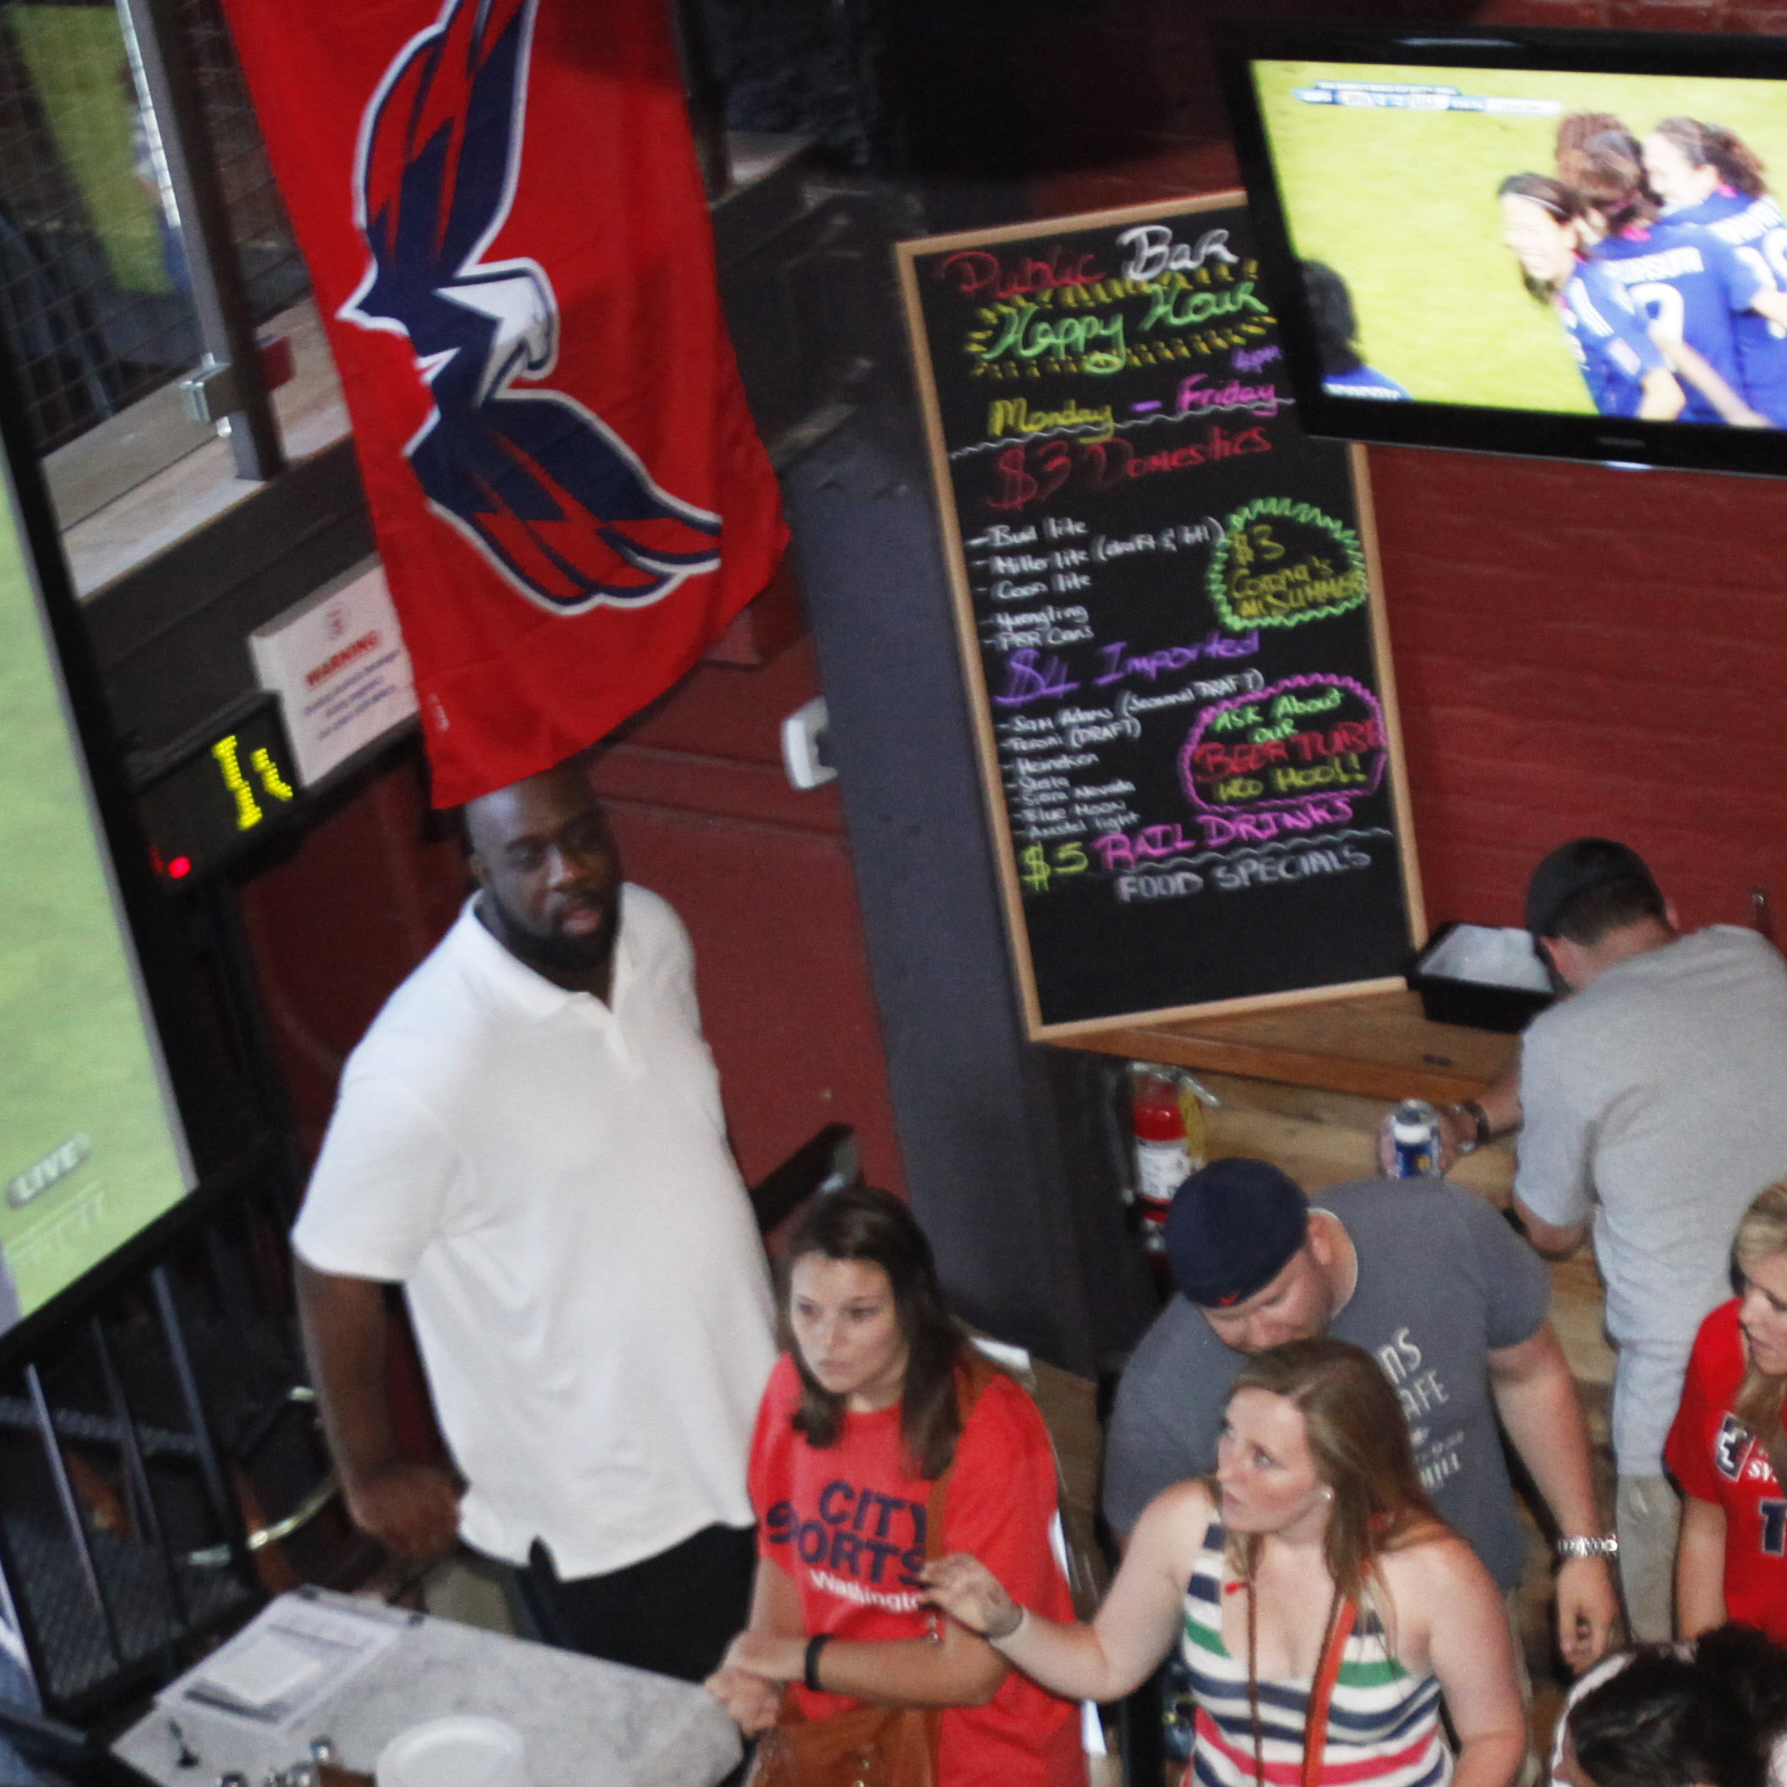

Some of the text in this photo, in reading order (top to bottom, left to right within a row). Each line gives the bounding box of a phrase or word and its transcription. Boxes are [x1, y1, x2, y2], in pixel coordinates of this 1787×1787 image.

[981, 303, 1126, 373] Happy
[986, 397, 1114, 444] Monday
[1176, 373, 1277, 417] Friday
[989, 440, 1071, 511] $3
[987, 516, 1089, 547] Bud lite
[1233, 525, 1285, 566] $3
[989, 554, 1049, 576] Miller
[1049, 549, 1089, 570] lite
[1051, 573, 1091, 592] lite
[305, 629, 384, 690] WARNING
[1021, 796, 1354, 892] $5 RAIL DRINKS
[1119, 846, 1372, 902] FOOD SPECIALS
[766, 1499, 935, 1590] SORTS
